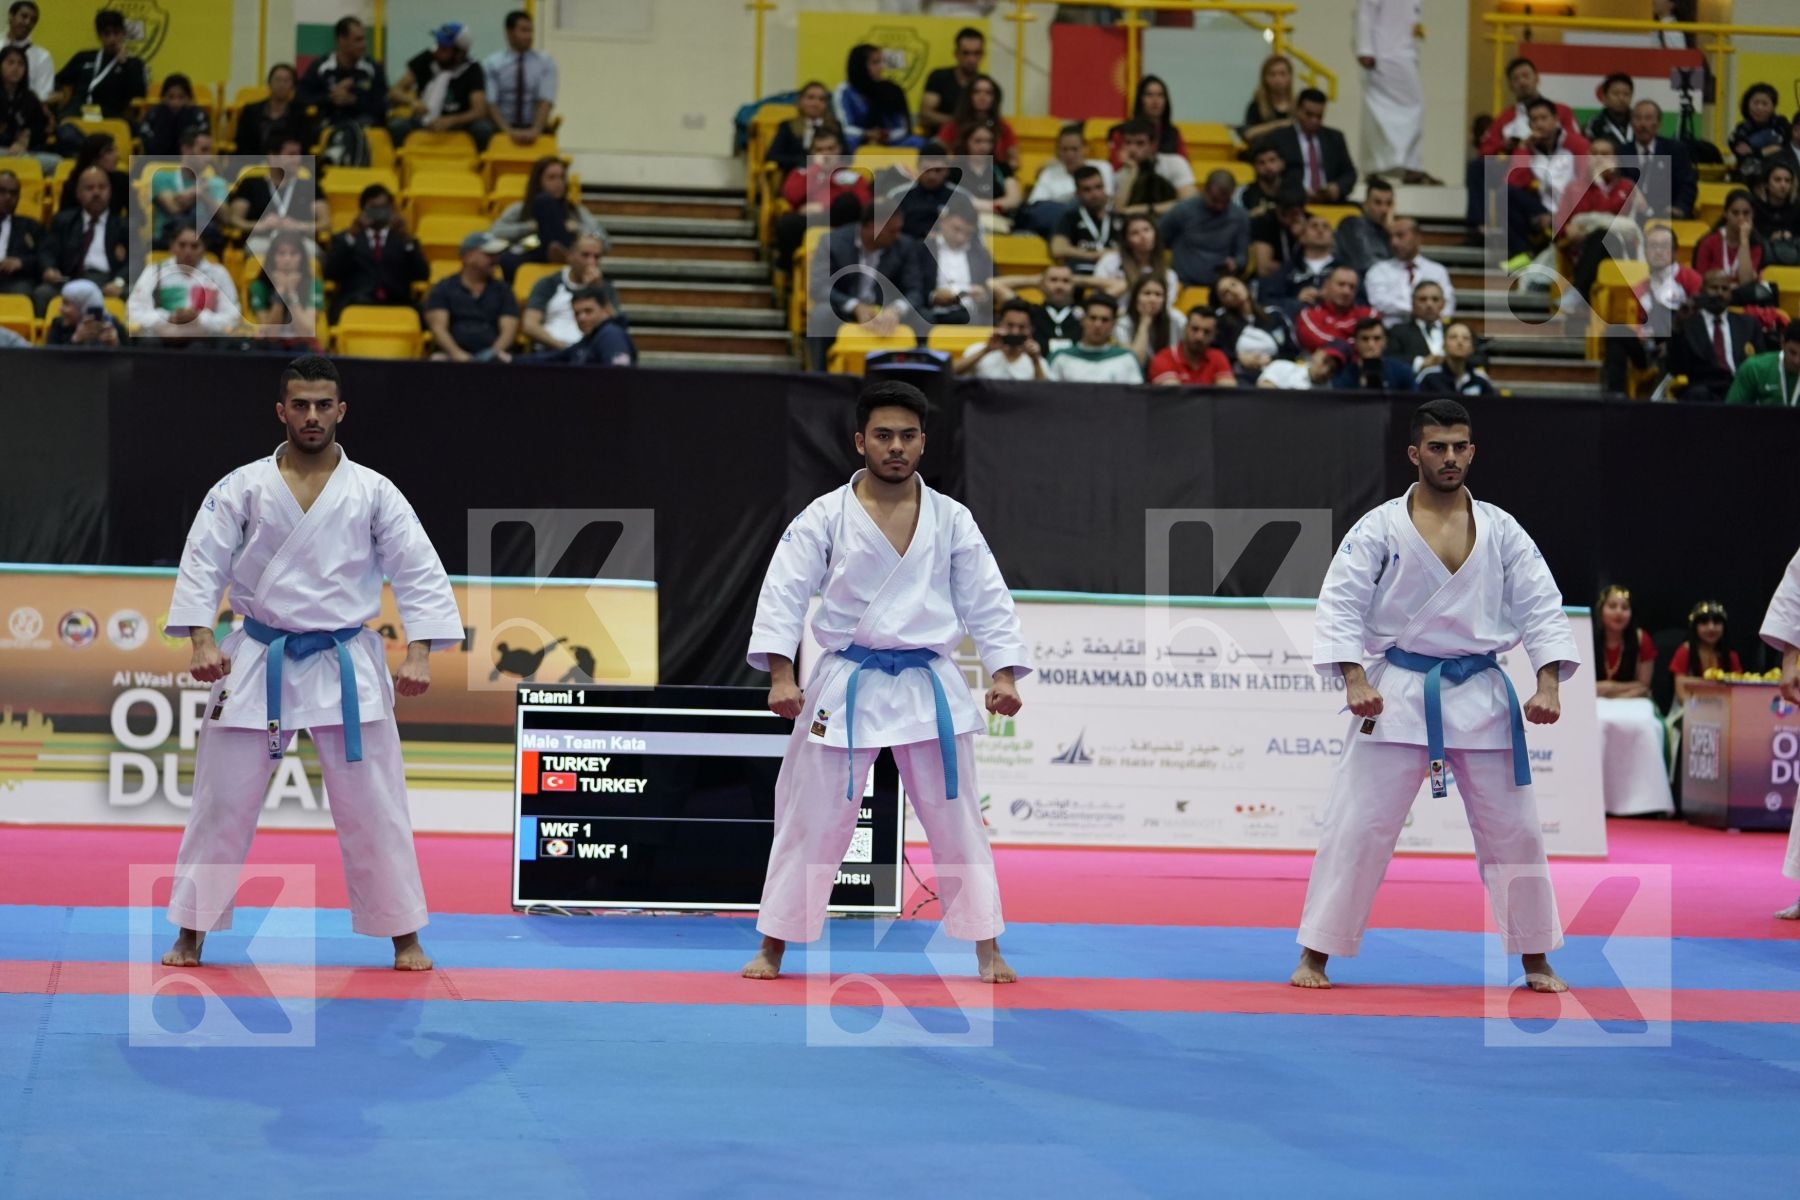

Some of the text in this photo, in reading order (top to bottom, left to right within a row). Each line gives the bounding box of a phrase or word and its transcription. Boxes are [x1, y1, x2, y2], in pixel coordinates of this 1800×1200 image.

[1038, 668, 1147, 687] MOHAMMAD
[1152, 671, 1204, 689] OMAR
[1210, 672, 1241, 690] BIN
[1246, 672, 1315, 692] HAIDER
[519, 688, 585, 705] Tatami 1
[523, 734, 647, 751] Male Team Kata
[542, 755, 611, 772] TURKEY
[579, 777, 648, 793] TURKEY
[540, 822, 591, 838] WKF 1
[577, 843, 628, 859] WKF 1
